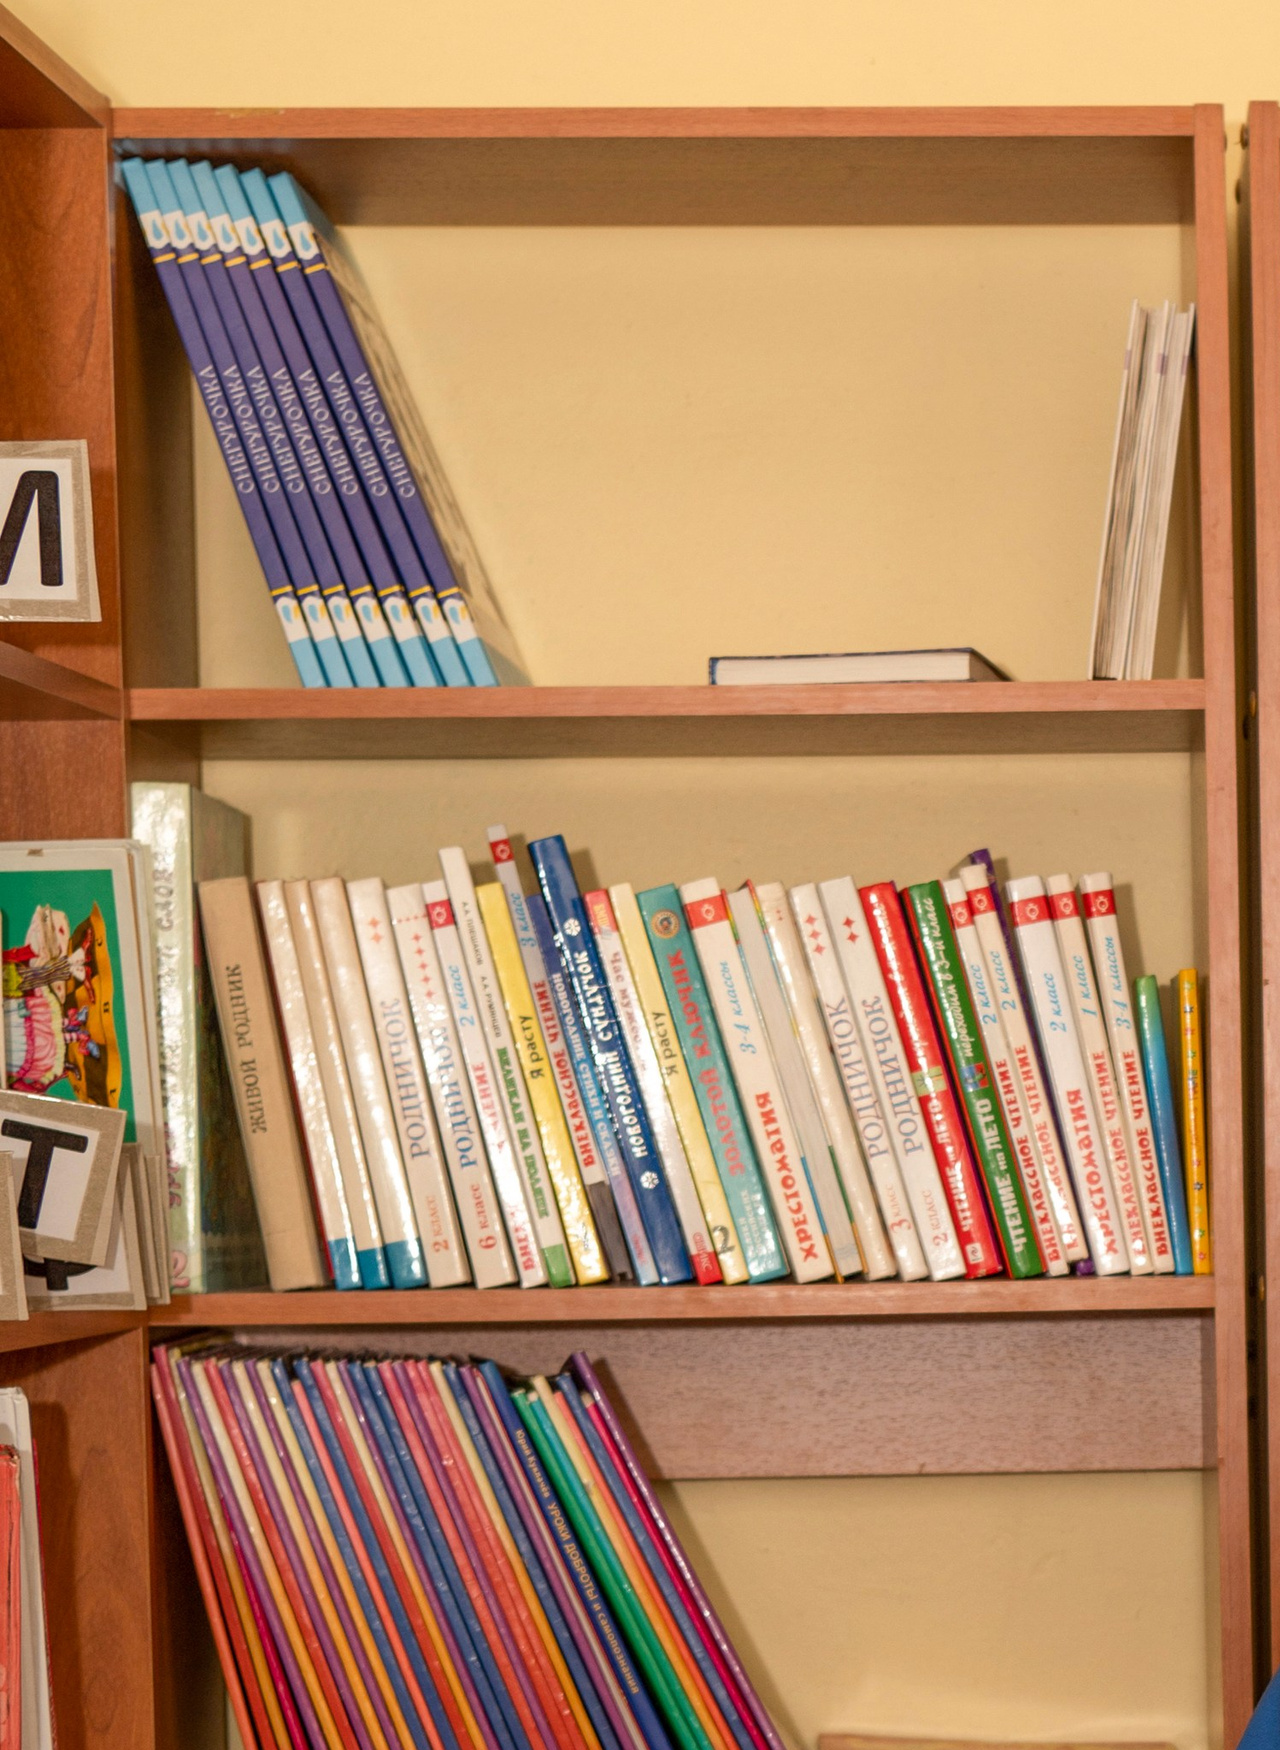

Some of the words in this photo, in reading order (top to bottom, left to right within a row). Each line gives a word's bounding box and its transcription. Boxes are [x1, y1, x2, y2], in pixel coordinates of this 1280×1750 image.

[199, 365, 254, 494] СНЕГУРОЧКА
[222, 365, 279, 493] СНЕГУРОЧКА
[247, 366, 304, 494] СНЕГУРОЧКА
[273, 367, 331, 495] СНЕГУРОЧКА
[298, 369, 358, 495] СНЕГУРОЧКА
[326, 371, 387, 497] СНЕГУРОЧКА
[354, 373, 415, 498] СНЕГУРОЧКА
[519, 936, 538, 948] 3
[990, 951, 1012, 996] класс
[1072, 955, 1092, 1000] класс
[1103, 935, 1123, 992] классы
[225, 963, 254, 1048] РОДНИК
[447, 965, 469, 1010] класс
[458, 1013, 476, 1028] 2
[532, 979, 561, 1045] ЧТЕНИЕ
[667, 949, 712, 1059] КЛЮЧИК
[719, 960, 743, 1016] классы
[970, 964, 991, 1009] класс
[981, 1013, 998, 1026] 2
[1001, 999, 1017, 1012] 2
[1043, 973, 1064, 1018] класс
[518, 1014, 545, 1064] расту
[652, 1010, 679, 1060] расту
[1049, 1020, 1068, 1033] 2
[239, 1057, 267, 1134] ЖИВОЙ
[380, 997, 431, 1161] РОДНИЧОК
[530, 1069, 546, 1080] Я
[665, 1065, 680, 1077] Я
[825, 997, 890, 1159] РОДНИЧОК
[861, 995, 925, 1156] РОДНИЧОК
[995, 1057, 1022, 1129] ЧТЕНИЕ
[1014, 1043, 1042, 1115] ЧТЕНИЕ
[1092, 1050, 1118, 1121] ЧТЕНИЕ
[1123, 1049, 1145, 1120] ЧТЕНИЕ
[553, 1048, 597, 1168] ВНЕКЛАССНОЕ
[698, 1066, 746, 1178] ЗОЛОТОЙ
[975, 1097, 1003, 1152] ЛЕТО
[2, 1118, 88, 1230] Т
[754, 1090, 819, 1262] ХРЕСТОМАТИЯ
[1016, 1134, 1061, 1263] ВНЕКЛАССНОЕ
[1065, 1087, 1120, 1256] ХРЕСТОМАТИЯ
[1136, 1126, 1169, 1256] ВНЕКЛАССНОЕ
[479, 1234, 497, 1250] 6
[932, 1231, 949, 1247] 2
[993, 1173, 1029, 1253] ЧТЕНИЕ
[515, 1428, 535, 1457] Юрий
[547, 1501, 572, 1542] УРОКИ
[563, 1540, 599, 1601] ДОБРОТЫ
[597, 1611, 640, 1695] самопознания
